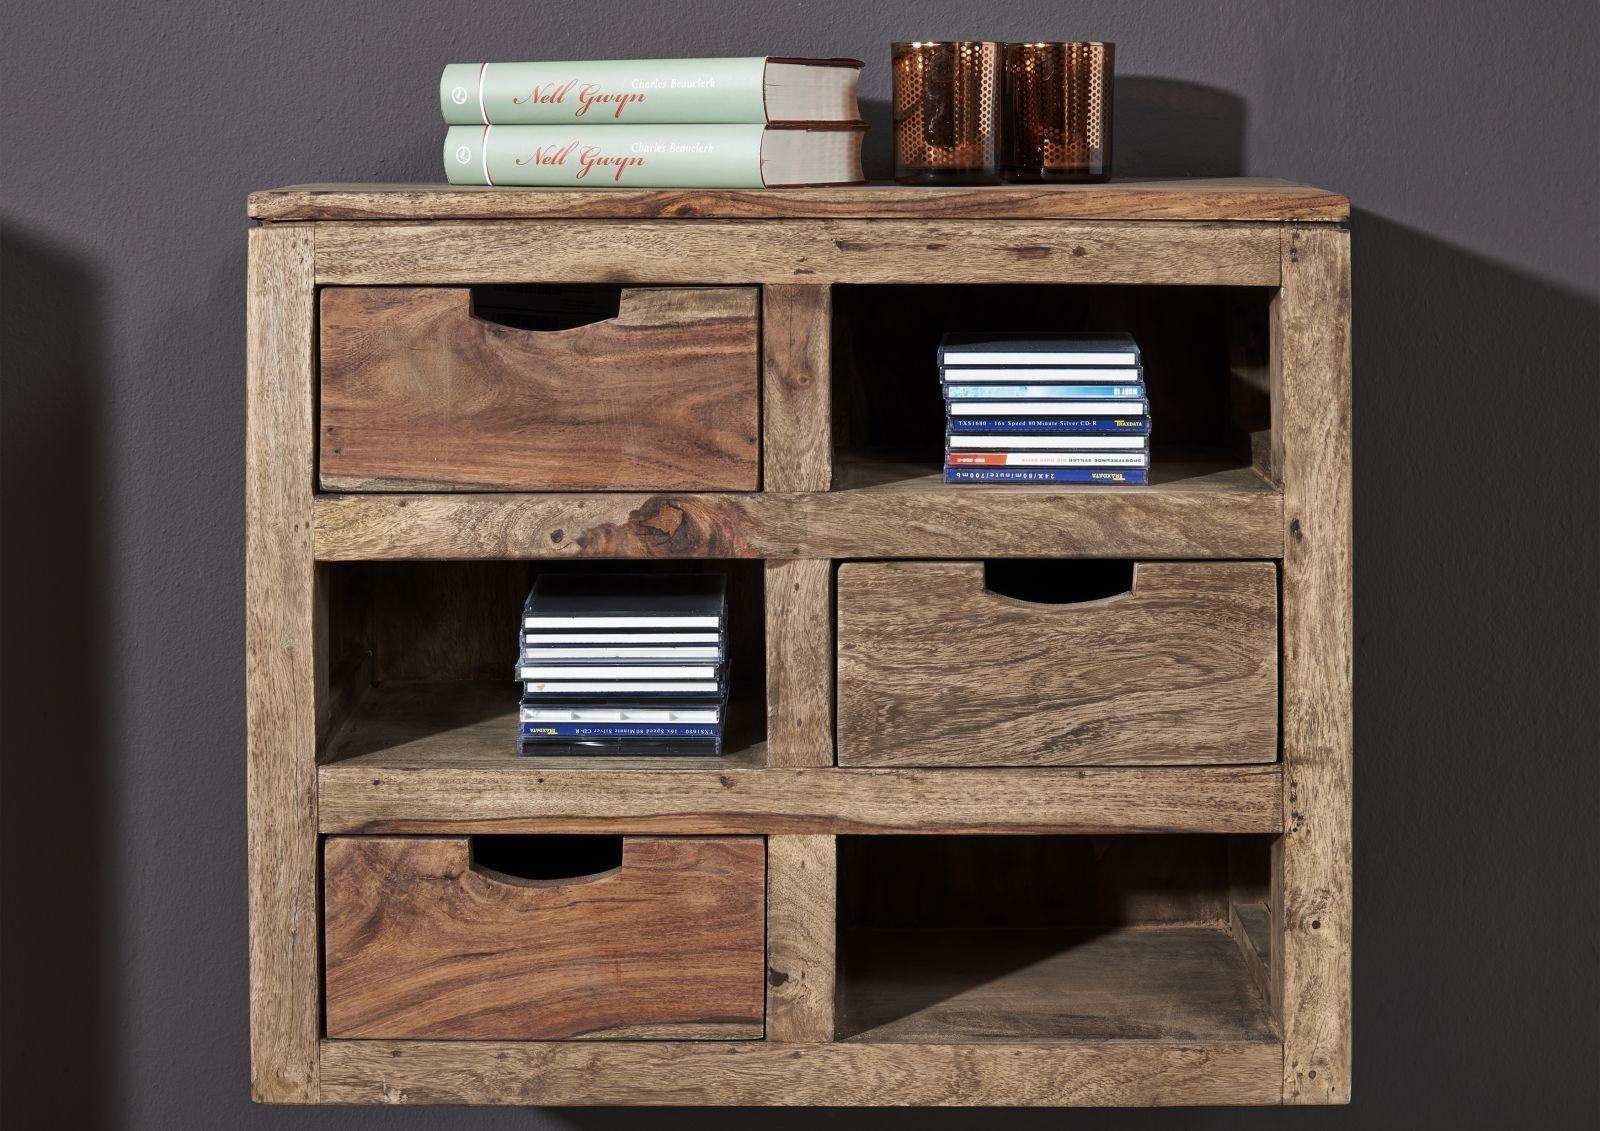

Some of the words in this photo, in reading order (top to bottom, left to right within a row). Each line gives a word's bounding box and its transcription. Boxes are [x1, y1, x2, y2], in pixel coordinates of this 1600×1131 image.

[631, 78, 667, 89] Charles
[670, 78, 716, 89] Beauclerk
[513, 78, 579, 105] Nell
[575, 83, 647, 118] Gwyn
[631, 142, 666, 153] Charles
[669, 142, 715, 153] Beauclerk
[515, 140, 580, 166] Nell
[575, 145, 646, 182] Gwyn
[1007, 420, 1026, 428] Speed
